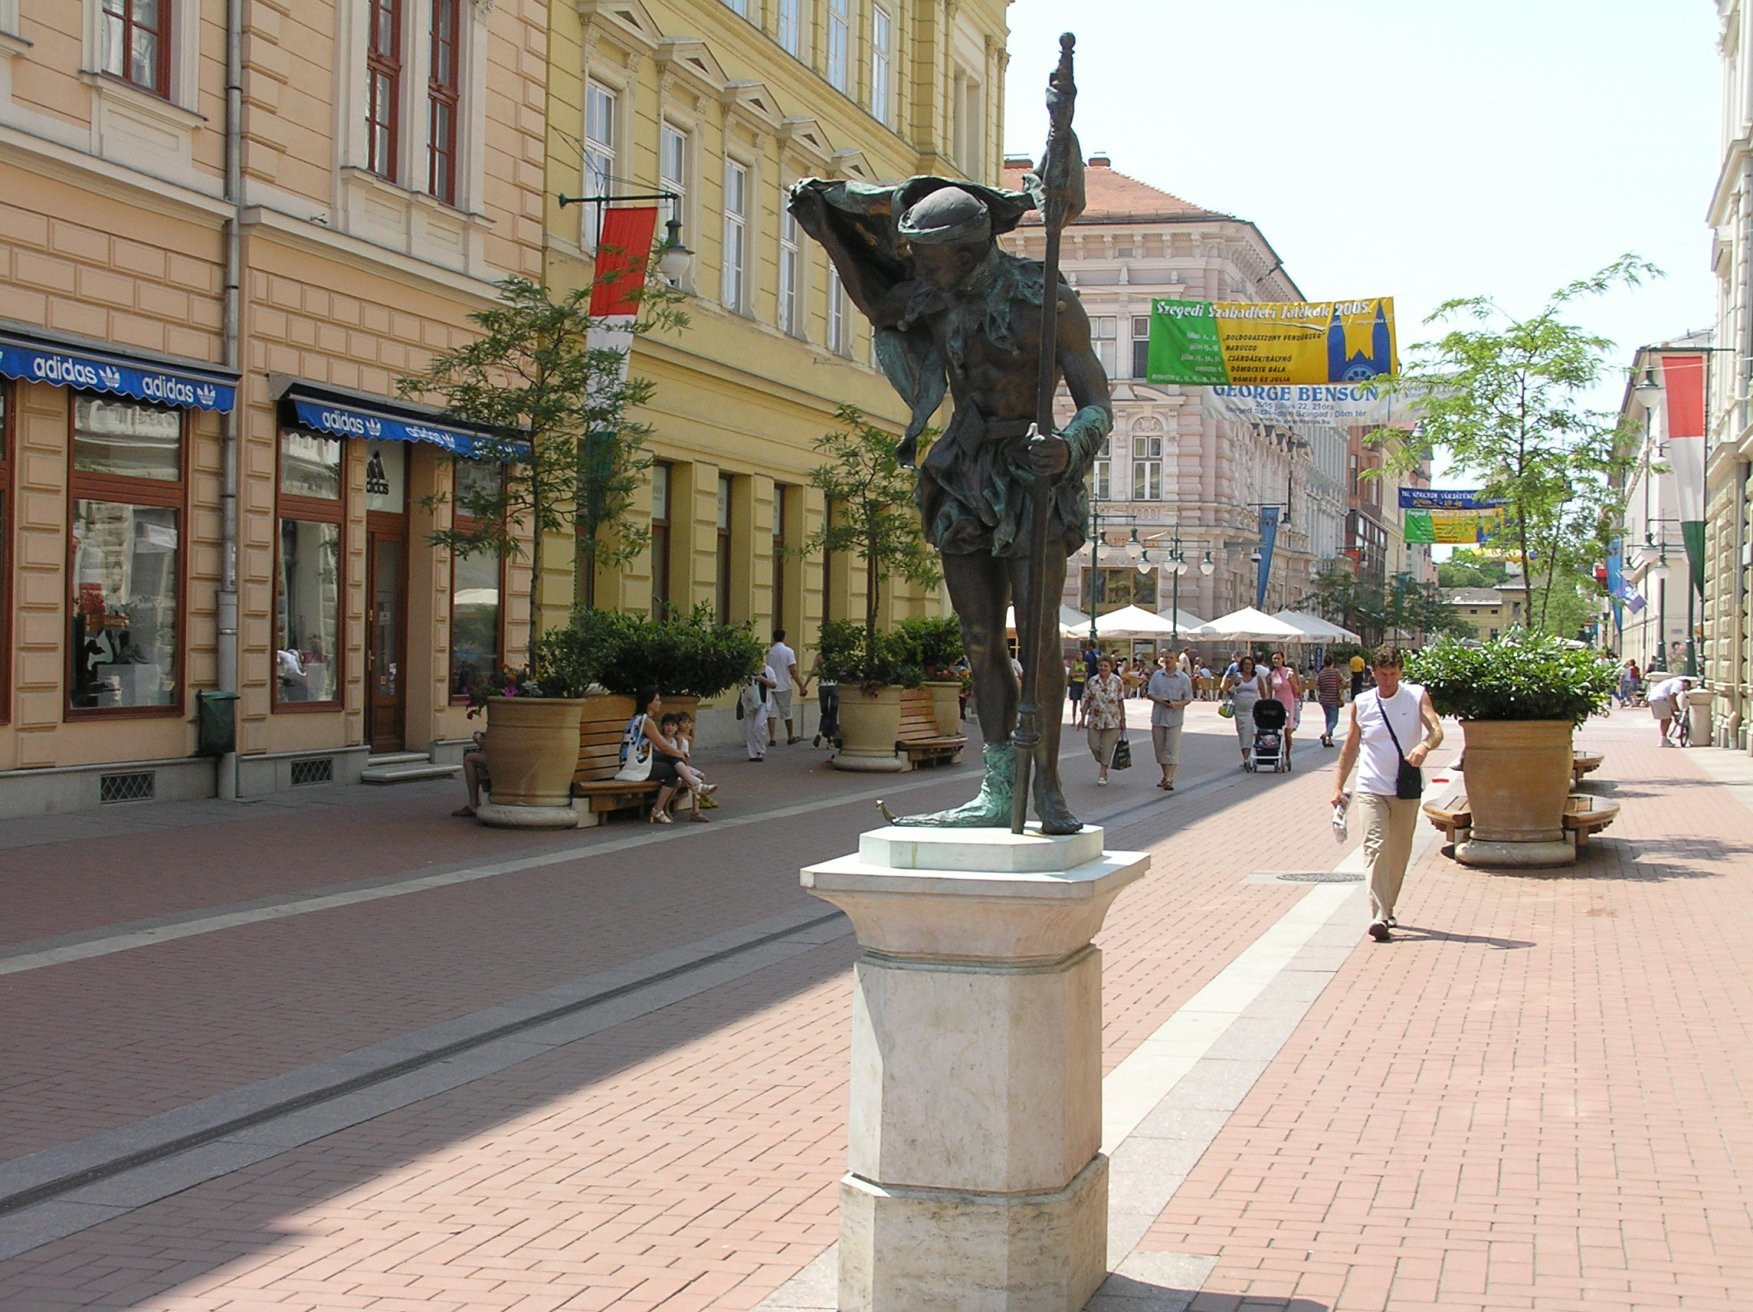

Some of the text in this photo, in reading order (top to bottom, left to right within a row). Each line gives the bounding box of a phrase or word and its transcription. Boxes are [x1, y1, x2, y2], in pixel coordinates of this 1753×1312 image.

[1157, 302, 1205, 319] Szegedi
[1208, 305, 1276, 318] Szabadtéri
[33, 355, 98, 385] adidas
[142, 374, 194, 403] adidas
[1213, 384, 1379, 401] GEORGE BENSON
[321, 410, 366, 434] adidas
